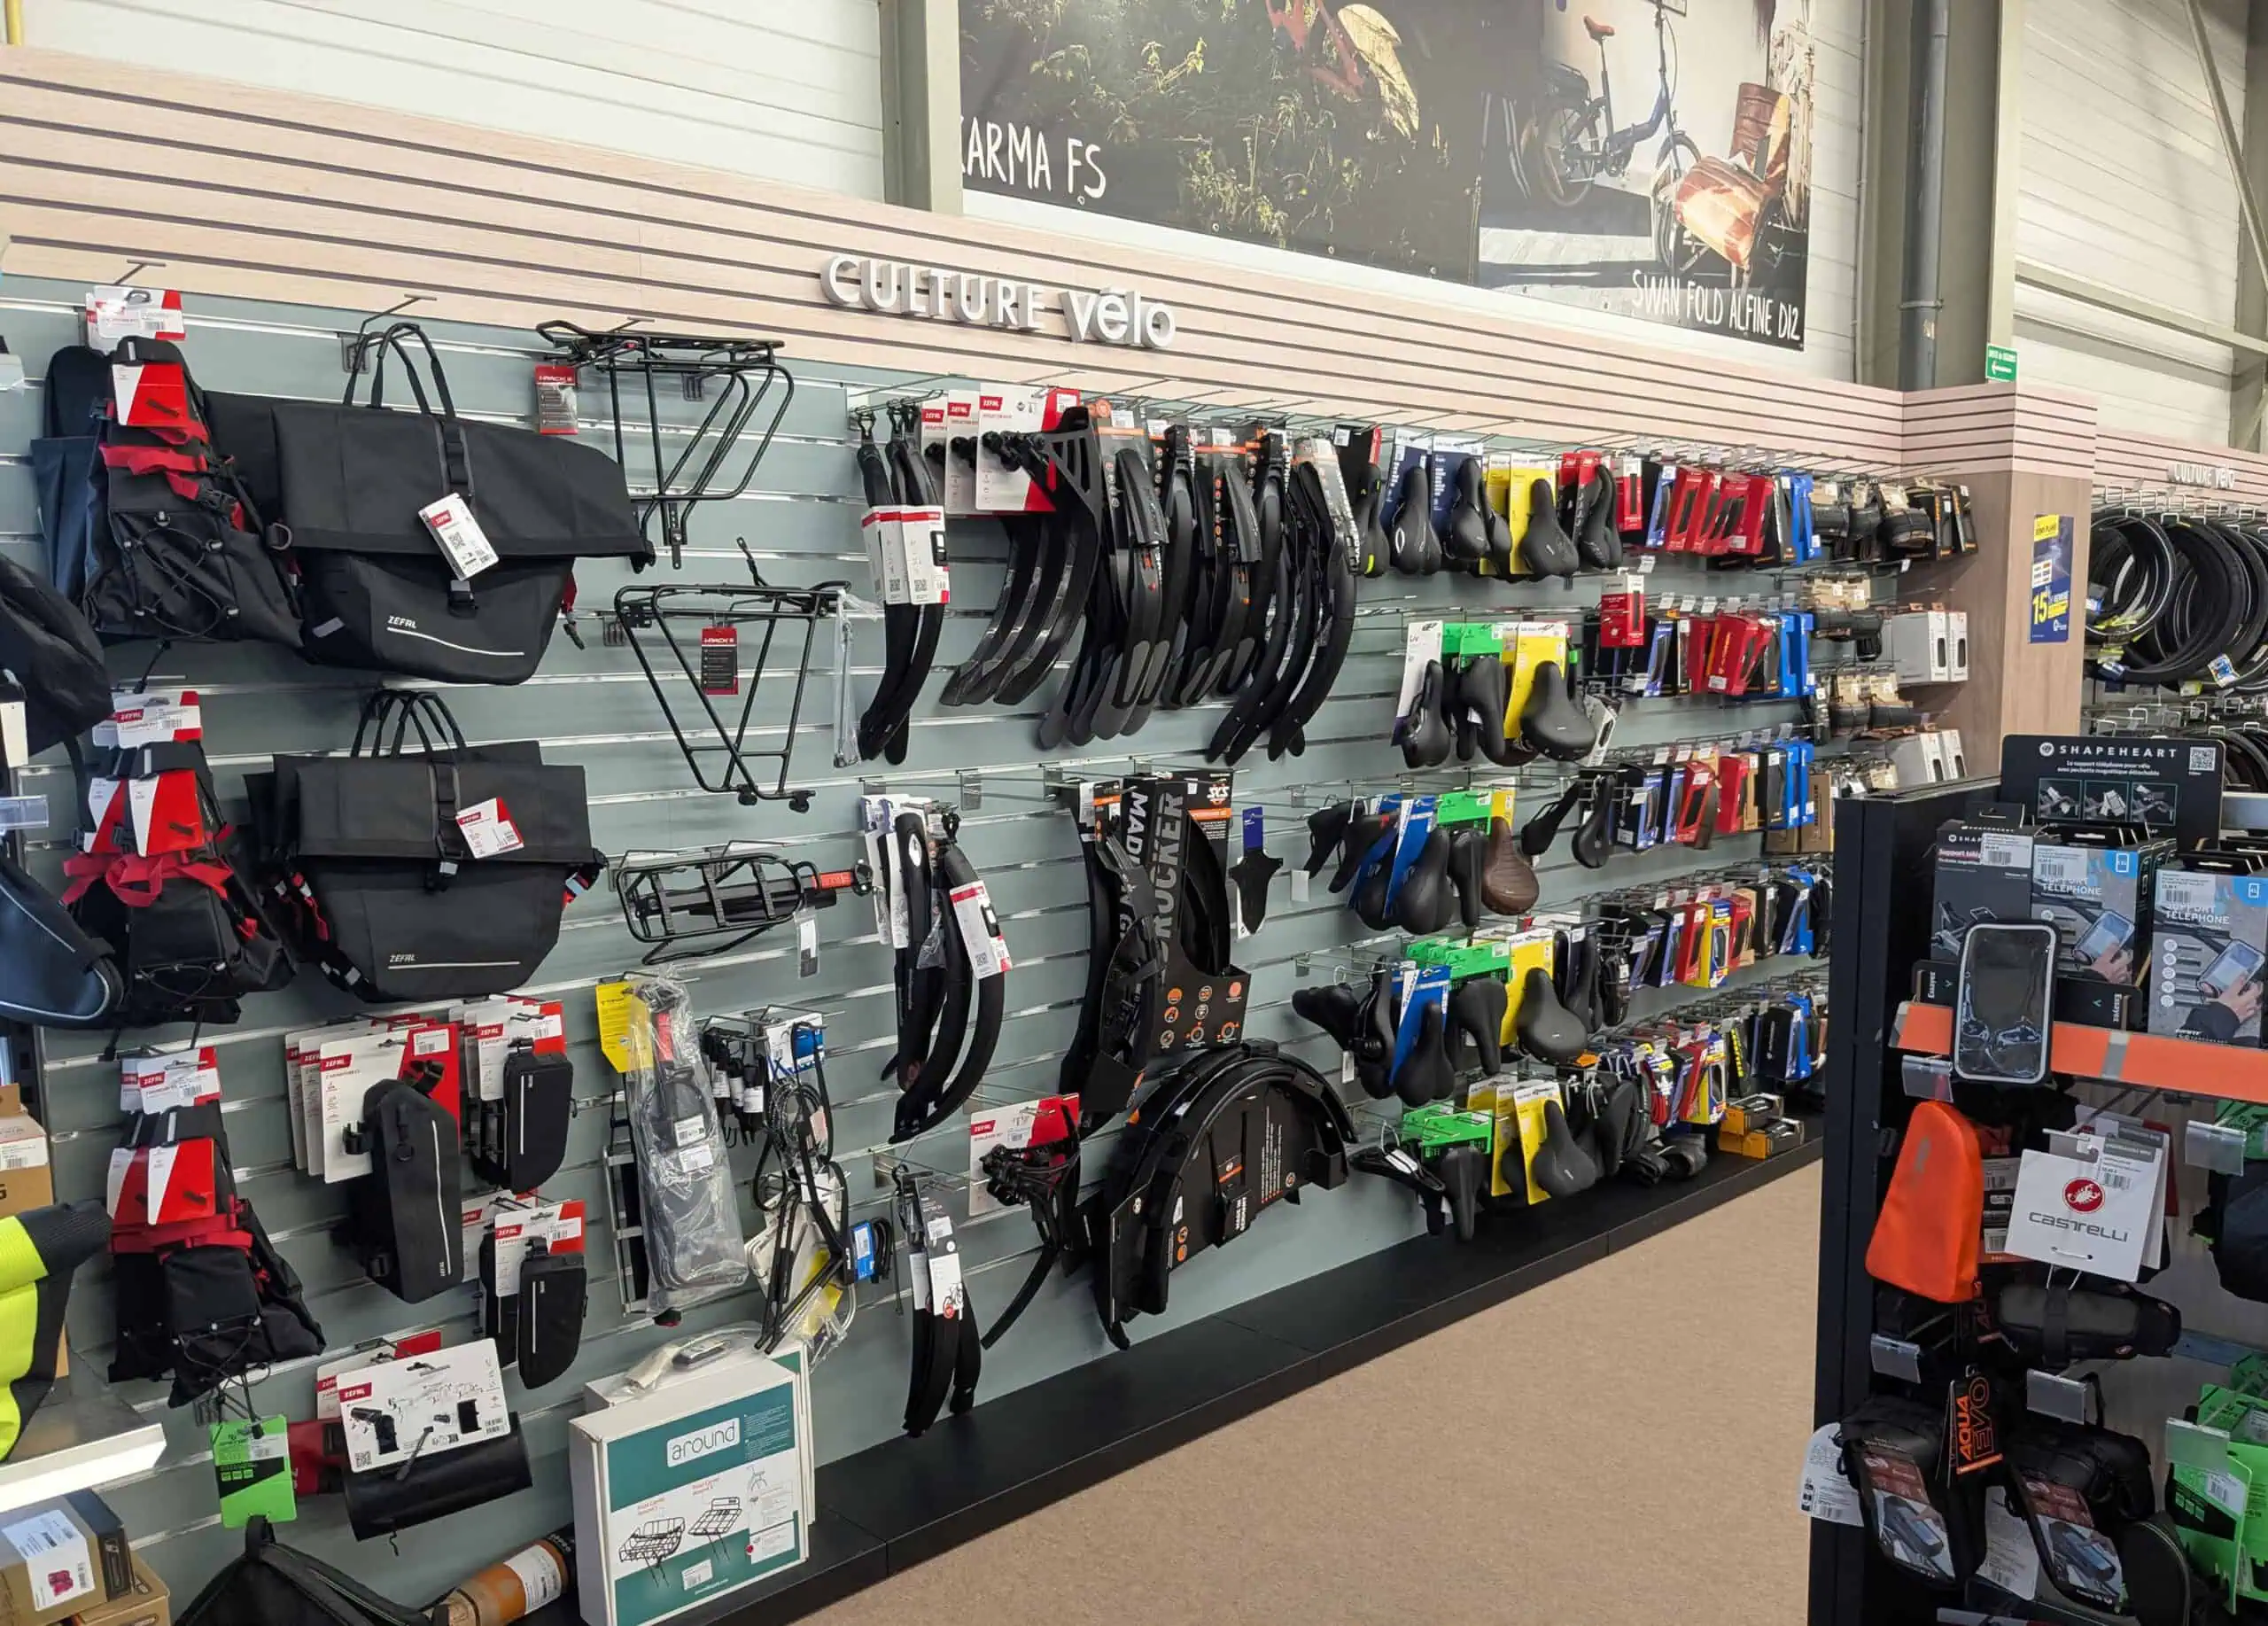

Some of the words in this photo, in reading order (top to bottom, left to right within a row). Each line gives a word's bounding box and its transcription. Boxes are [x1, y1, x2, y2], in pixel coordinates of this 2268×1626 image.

[961, 115, 1052, 191] ARMA
[1068, 137, 1106, 198] FS
[820, 253, 1045, 331] CULTURE
[1632, 269, 1680, 316] SWAN
[1687, 281, 1723, 325] FOLD
[1729, 290, 1774, 336] ALFINE
[388, 615, 417, 629] ZEFAL
[2032, 592, 2047, 624] 15
[2059, 744, 2178, 758] SHAPEHEART
[389, 953, 416, 963] ZEFAL
[672, 1421, 735, 1461] around
[1956, 1396, 1973, 1460] AQUA
[1969, 1377, 1995, 1459] EVO
